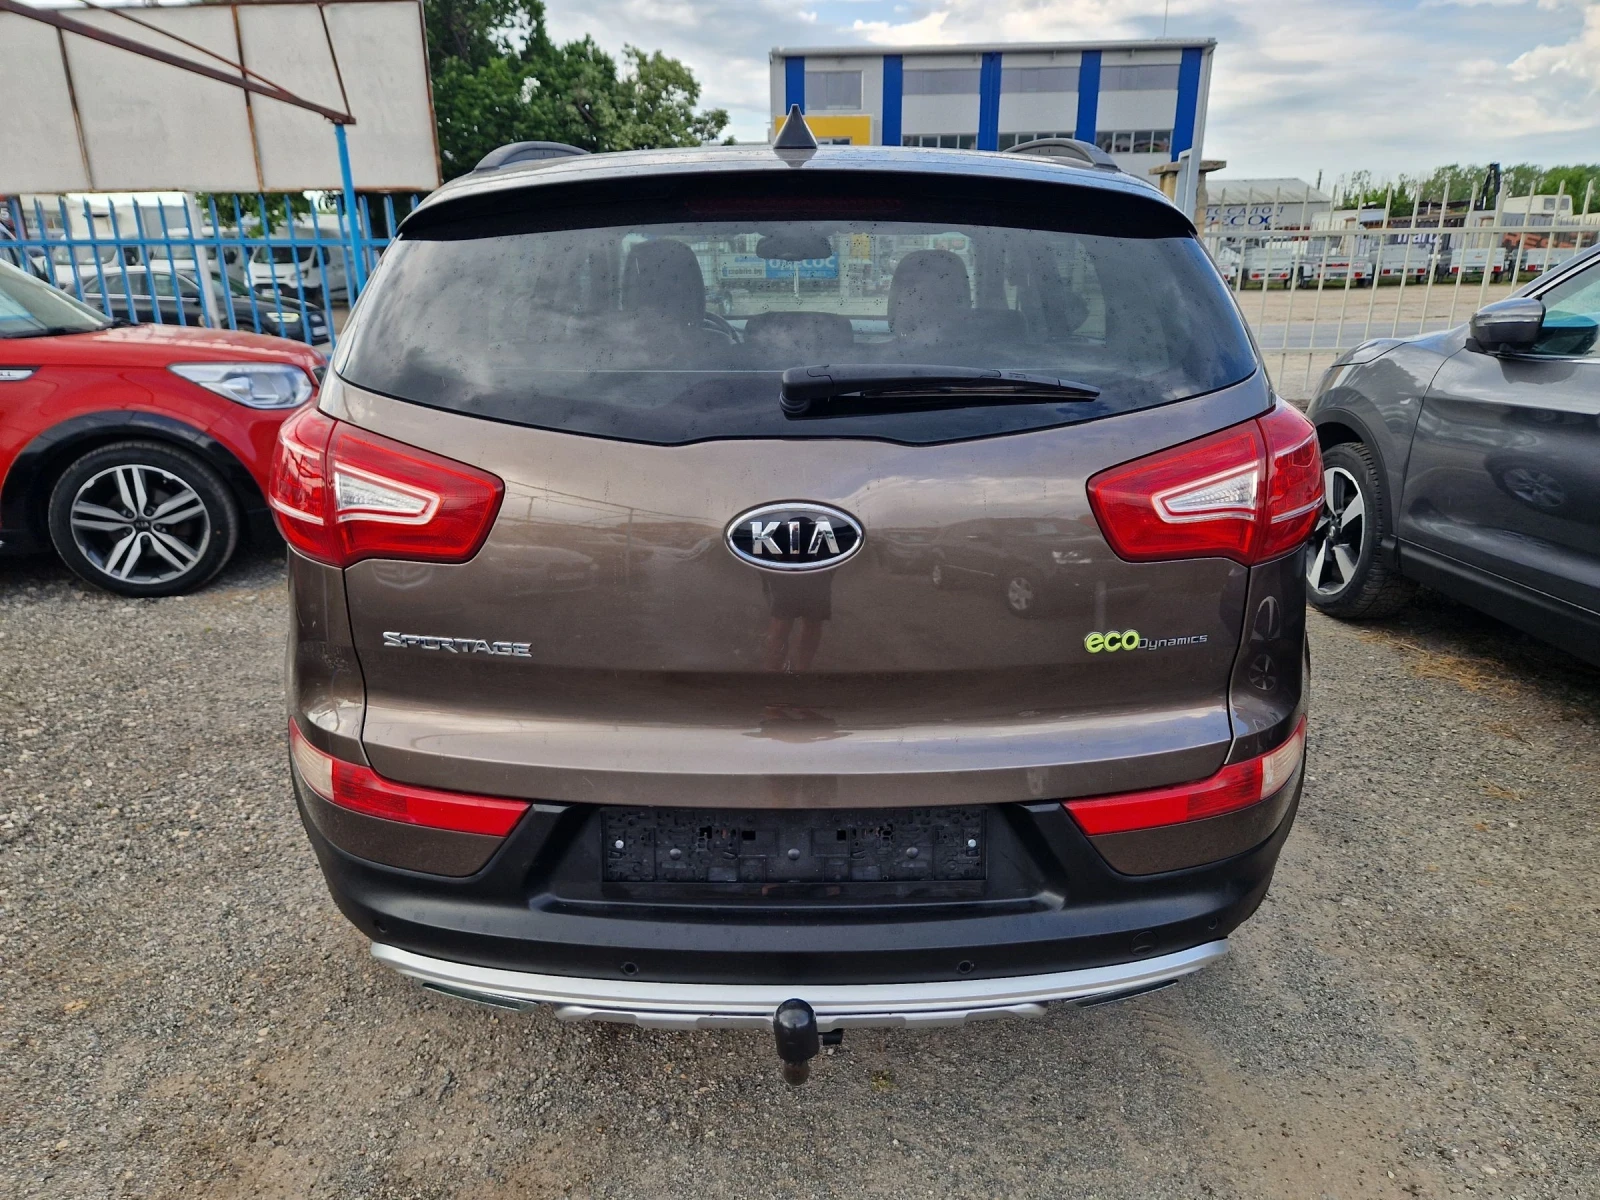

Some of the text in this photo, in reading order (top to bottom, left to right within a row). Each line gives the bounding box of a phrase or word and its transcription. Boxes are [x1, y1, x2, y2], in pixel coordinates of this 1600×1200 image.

[750, 521, 841, 555] KIA
[382, 631, 533, 658] SPORTAGE
[1084, 629, 1209, 653] eco Dynamics
